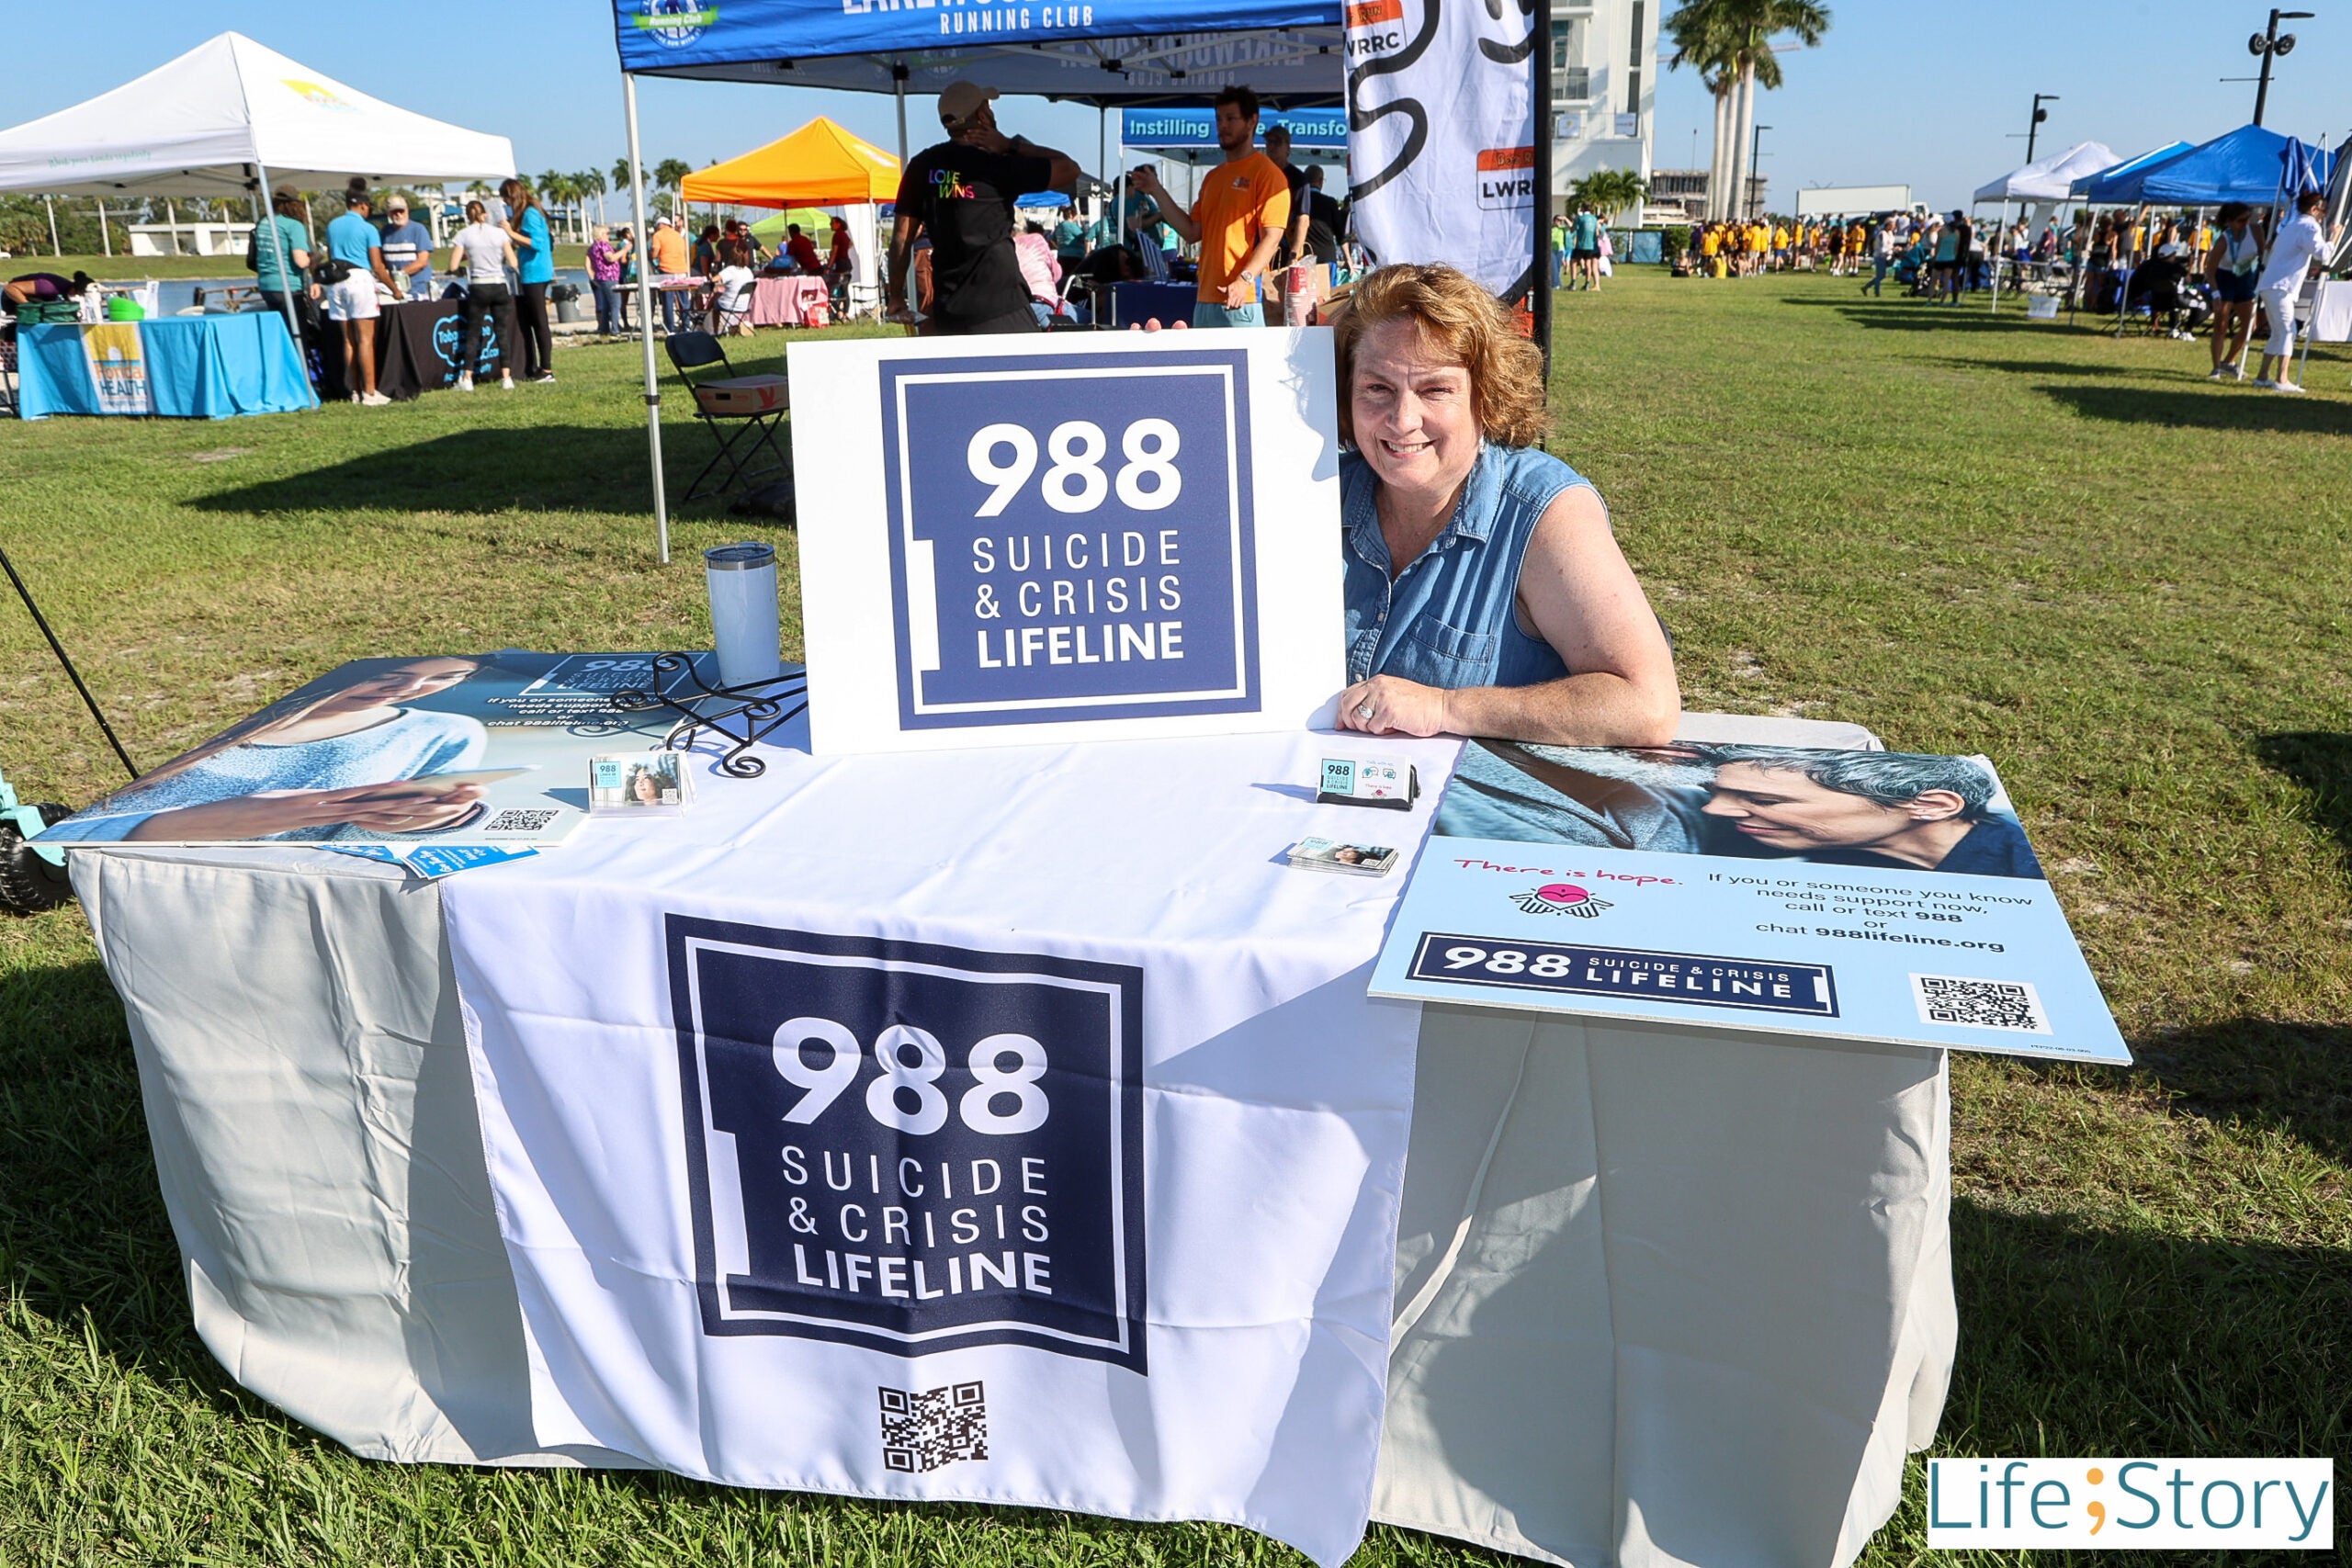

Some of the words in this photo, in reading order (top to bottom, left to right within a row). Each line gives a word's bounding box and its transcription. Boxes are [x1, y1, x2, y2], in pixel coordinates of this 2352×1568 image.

[683, 13, 703, 24] Club
[940, 7, 1030, 35] RUNNING
[1042, 6, 1093, 28] CLUB
[1130, 119, 1210, 139] Instilling
[1277, 118, 1348, 137] Transfo
[929, 169, 961, 184] LOVE
[939, 183, 976, 199] WINS
[1483, 179, 1534, 198] LWR
[967, 418, 1182, 518] 988
[972, 529, 1181, 574] SUICIDE
[974, 583, 1001, 619] &
[1019, 575, 1182, 617] CRISIS
[978, 621, 1184, 669] LIFELINE
[600, 764, 616, 773] 988
[1328, 764, 1350, 776] 988
[1453, 859, 1555, 875] There
[1566, 869, 1587, 878] is
[1597, 869, 1684, 887] hope.
[1708, 873, 1721, 883] If
[1728, 875, 1769, 886] you
[1776, 879, 1800, 888] or
[1806, 882, 1913, 897] someone
[1918, 889, 1962, 902] you
[1969, 891, 2033, 907] know
[1757, 888, 1826, 902] needs
[1833, 893, 1926, 910] support
[1933, 902, 1988, 915] now,
[1785, 900, 1825, 913] call
[1829, 906, 1857, 916] or
[1863, 907, 1908, 919] text
[1915, 911, 1963, 924] 988
[1863, 919, 1888, 930] or
[1756, 922, 1808, 936] chat
[1815, 927, 2006, 953] 988lifeline.org
[1443, 946, 1571, 978] 988
[1589, 956, 1680, 974] SUICIDE
[1690, 965, 1703, 975] &
[1712, 967, 1790, 982] CRISIS
[1586, 967, 1792, 999] LIFELINE
[773, 1017, 1050, 1135] 988
[781, 1145, 1048, 1199] SUICIDE
[788, 1197, 820, 1235] &
[840, 1203, 1049, 1248] CRISIS
[794, 1244, 1053, 1300] LIFELINE
